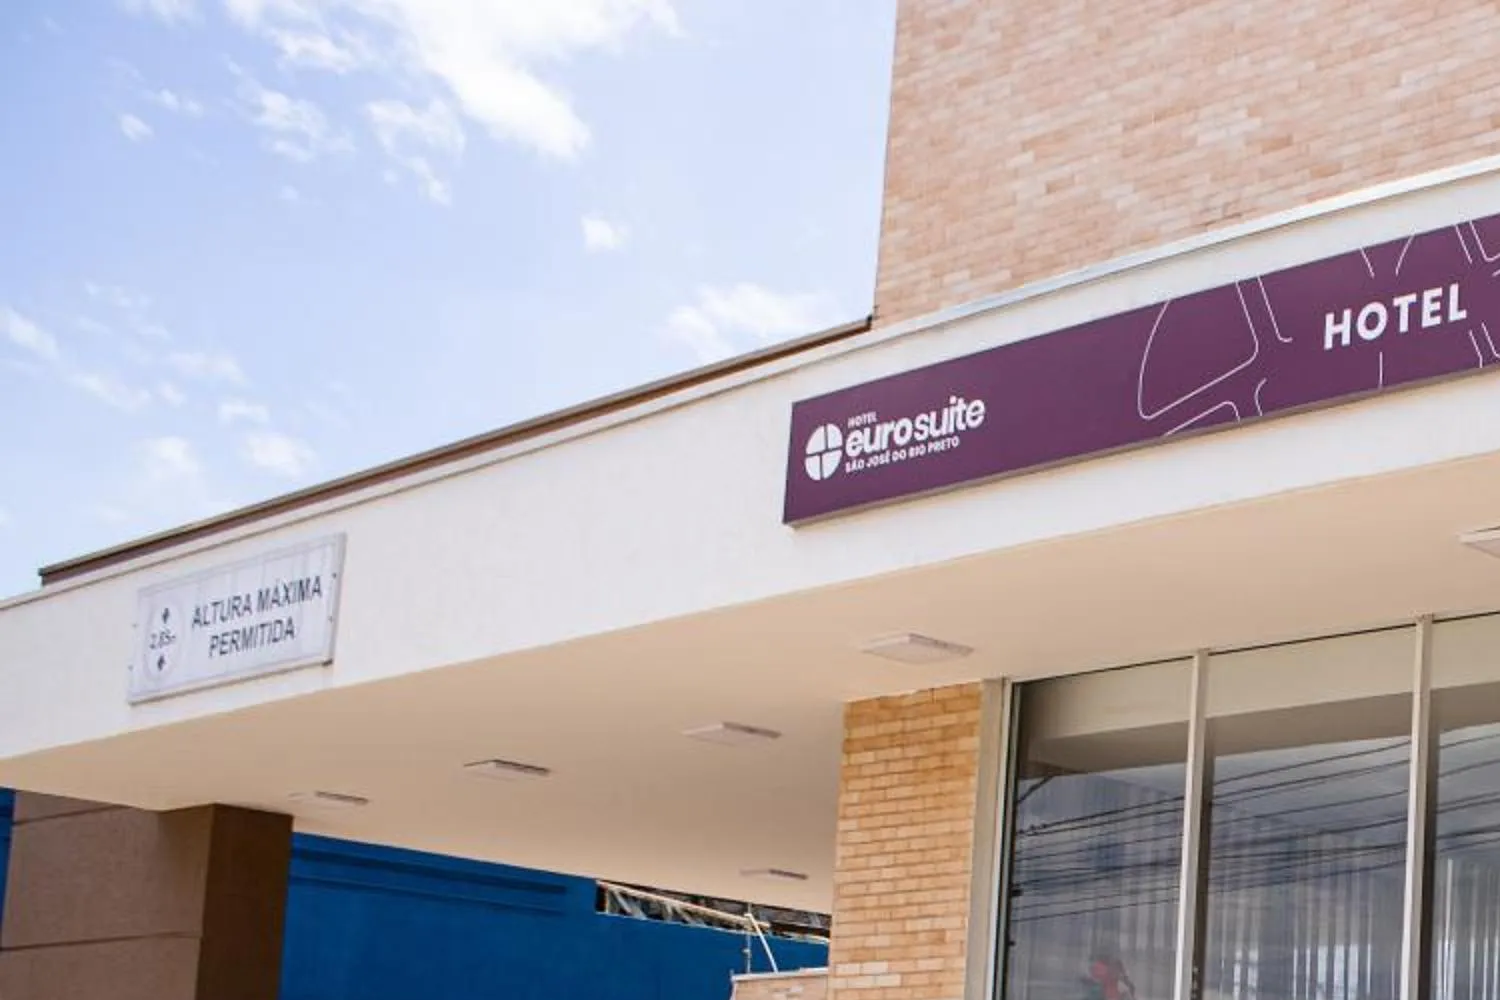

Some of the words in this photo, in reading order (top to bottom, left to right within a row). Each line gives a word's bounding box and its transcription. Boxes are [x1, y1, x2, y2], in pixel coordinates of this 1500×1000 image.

[1324, 282, 1468, 351] HOTEL
[848, 411, 878, 429] HOTEL
[892, 449, 907, 462] DO
[192, 594, 253, 629] ALTURA
[208, 616, 295, 657] PERMITIDA
